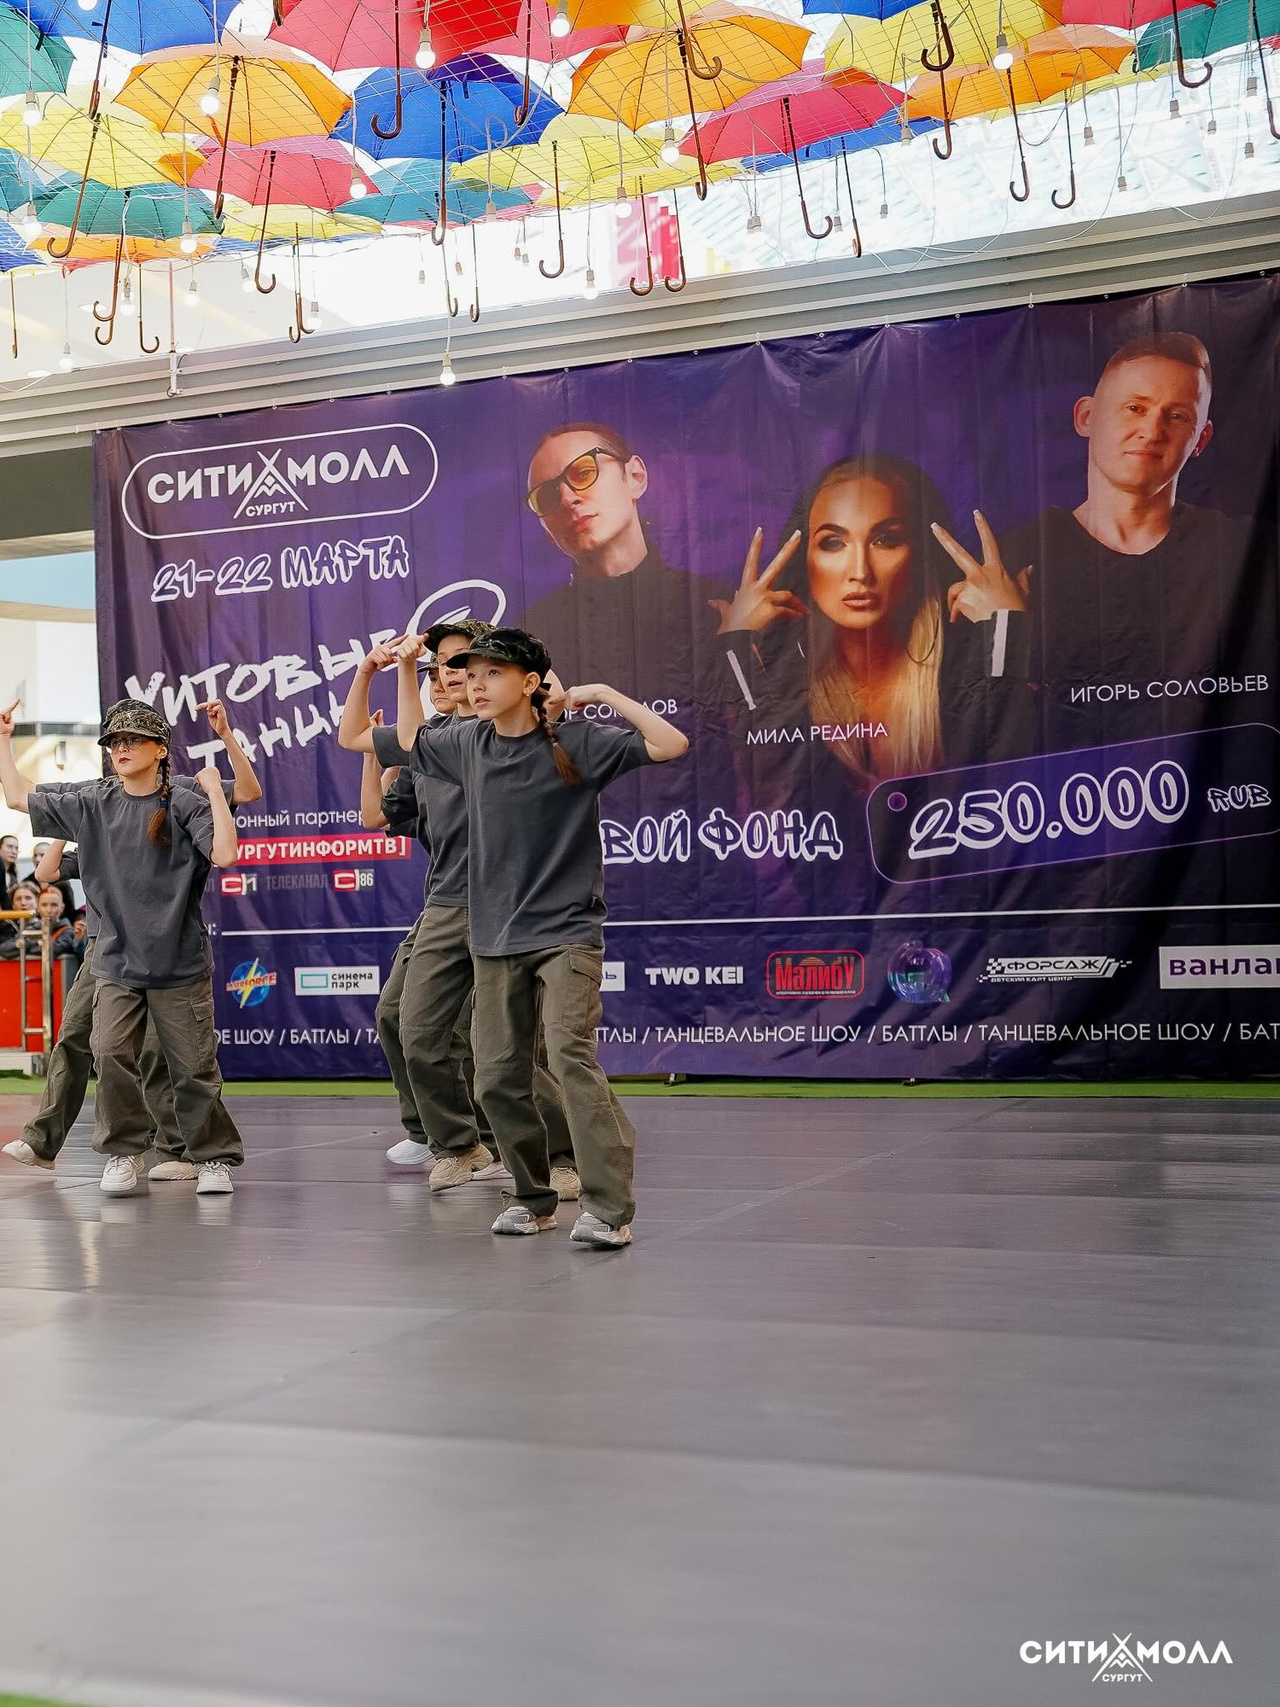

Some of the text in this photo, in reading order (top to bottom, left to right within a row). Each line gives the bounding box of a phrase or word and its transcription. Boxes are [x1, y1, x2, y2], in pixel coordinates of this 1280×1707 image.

[147, 444, 410, 504] СИТИ МОЛЛ
[245, 501, 296, 517] СУРГУТ
[151, 535, 409, 602] 21-22 МАРТА
[1070, 674, 1269, 703] ИГОРЬ СОЛОВЬЕВ
[746, 722, 888, 746] МИЛА РЕДИНА
[908, 760, 1272, 860] 250.000 RUB
[698, 807, 844, 861] ФОНД
[645, 966, 744, 985] TWO KEI
[1006, 959, 1100, 971] ФОРСАЖ
[331, 971, 373, 981] синема
[331, 981, 360, 991] парк
[234, 1029, 274, 1045] ШОУ
[290, 1028, 350, 1045] БАТТЛЫ
[655, 1026, 805, 1044] ТАНЦЕВАЛЬНОЕ
[811, 1025, 862, 1043] ШОУ
[882, 1024, 957, 1042] БАТТЛЫ
[978, 1023, 1151, 1043] ТАНЦЕВАЛЬНОЕ
[1158, 1023, 1215, 1041] ШОУ
[1239, 1023, 1280, 1040] БАТ
